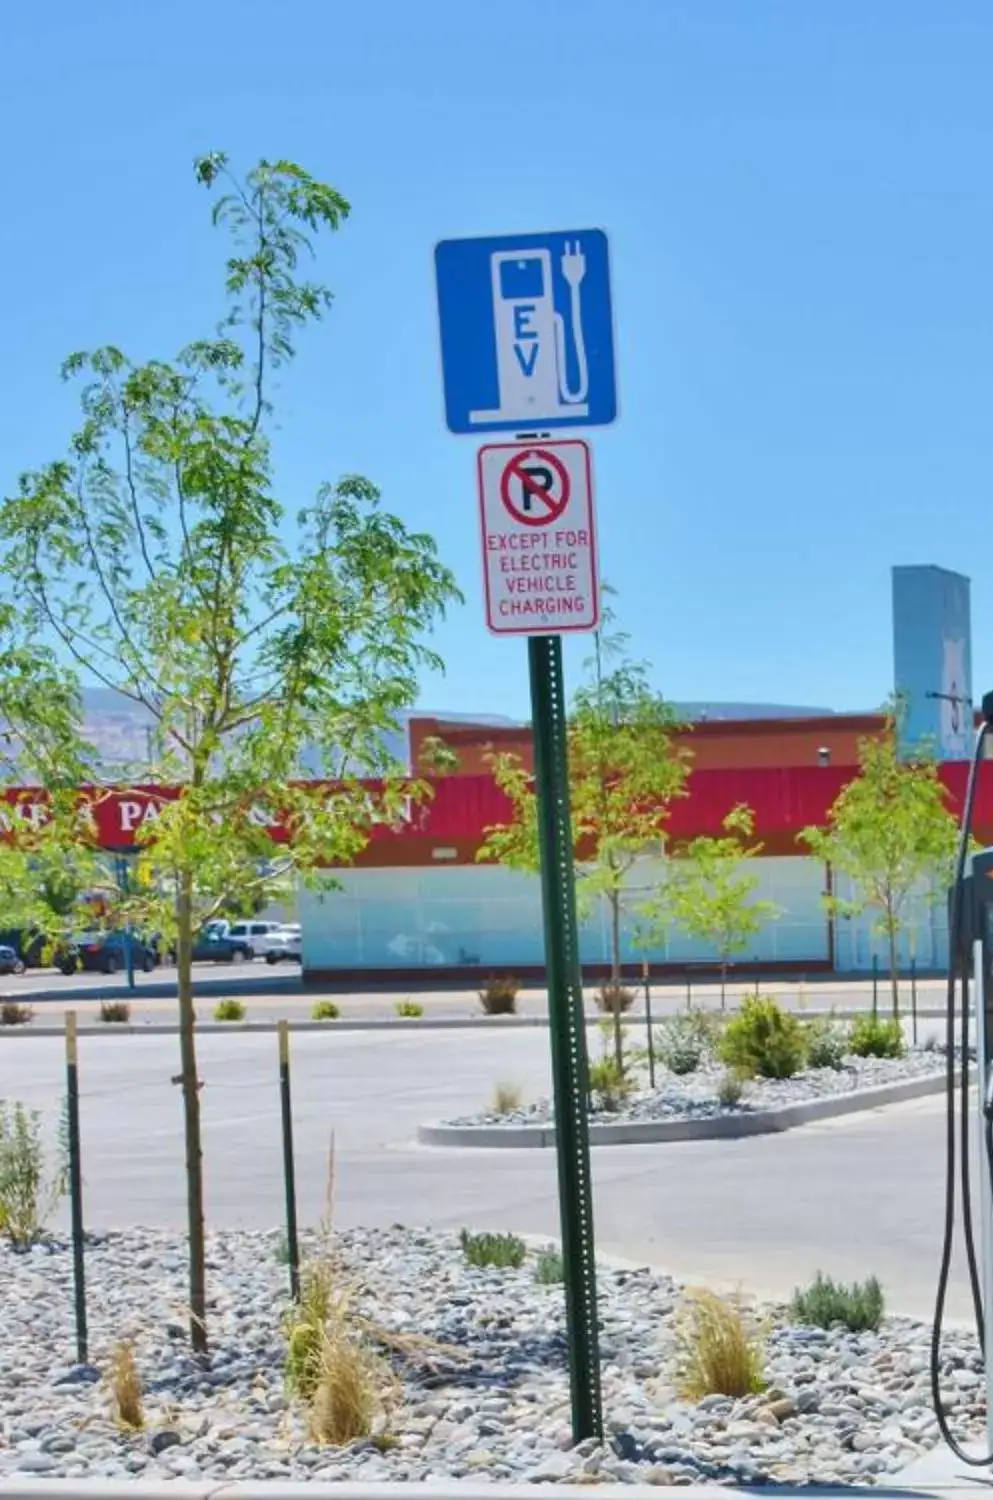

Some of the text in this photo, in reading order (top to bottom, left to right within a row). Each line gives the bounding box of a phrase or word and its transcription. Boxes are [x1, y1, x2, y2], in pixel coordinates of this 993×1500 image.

[513, 304, 538, 377] EV
[522, 467, 554, 511] P
[487, 529, 589, 551] EXCEPT FOR
[500, 553, 578, 573] ELECTRIC
[505, 575, 577, 594] VEHICLE
[499, 596, 585, 617] CHARGING
